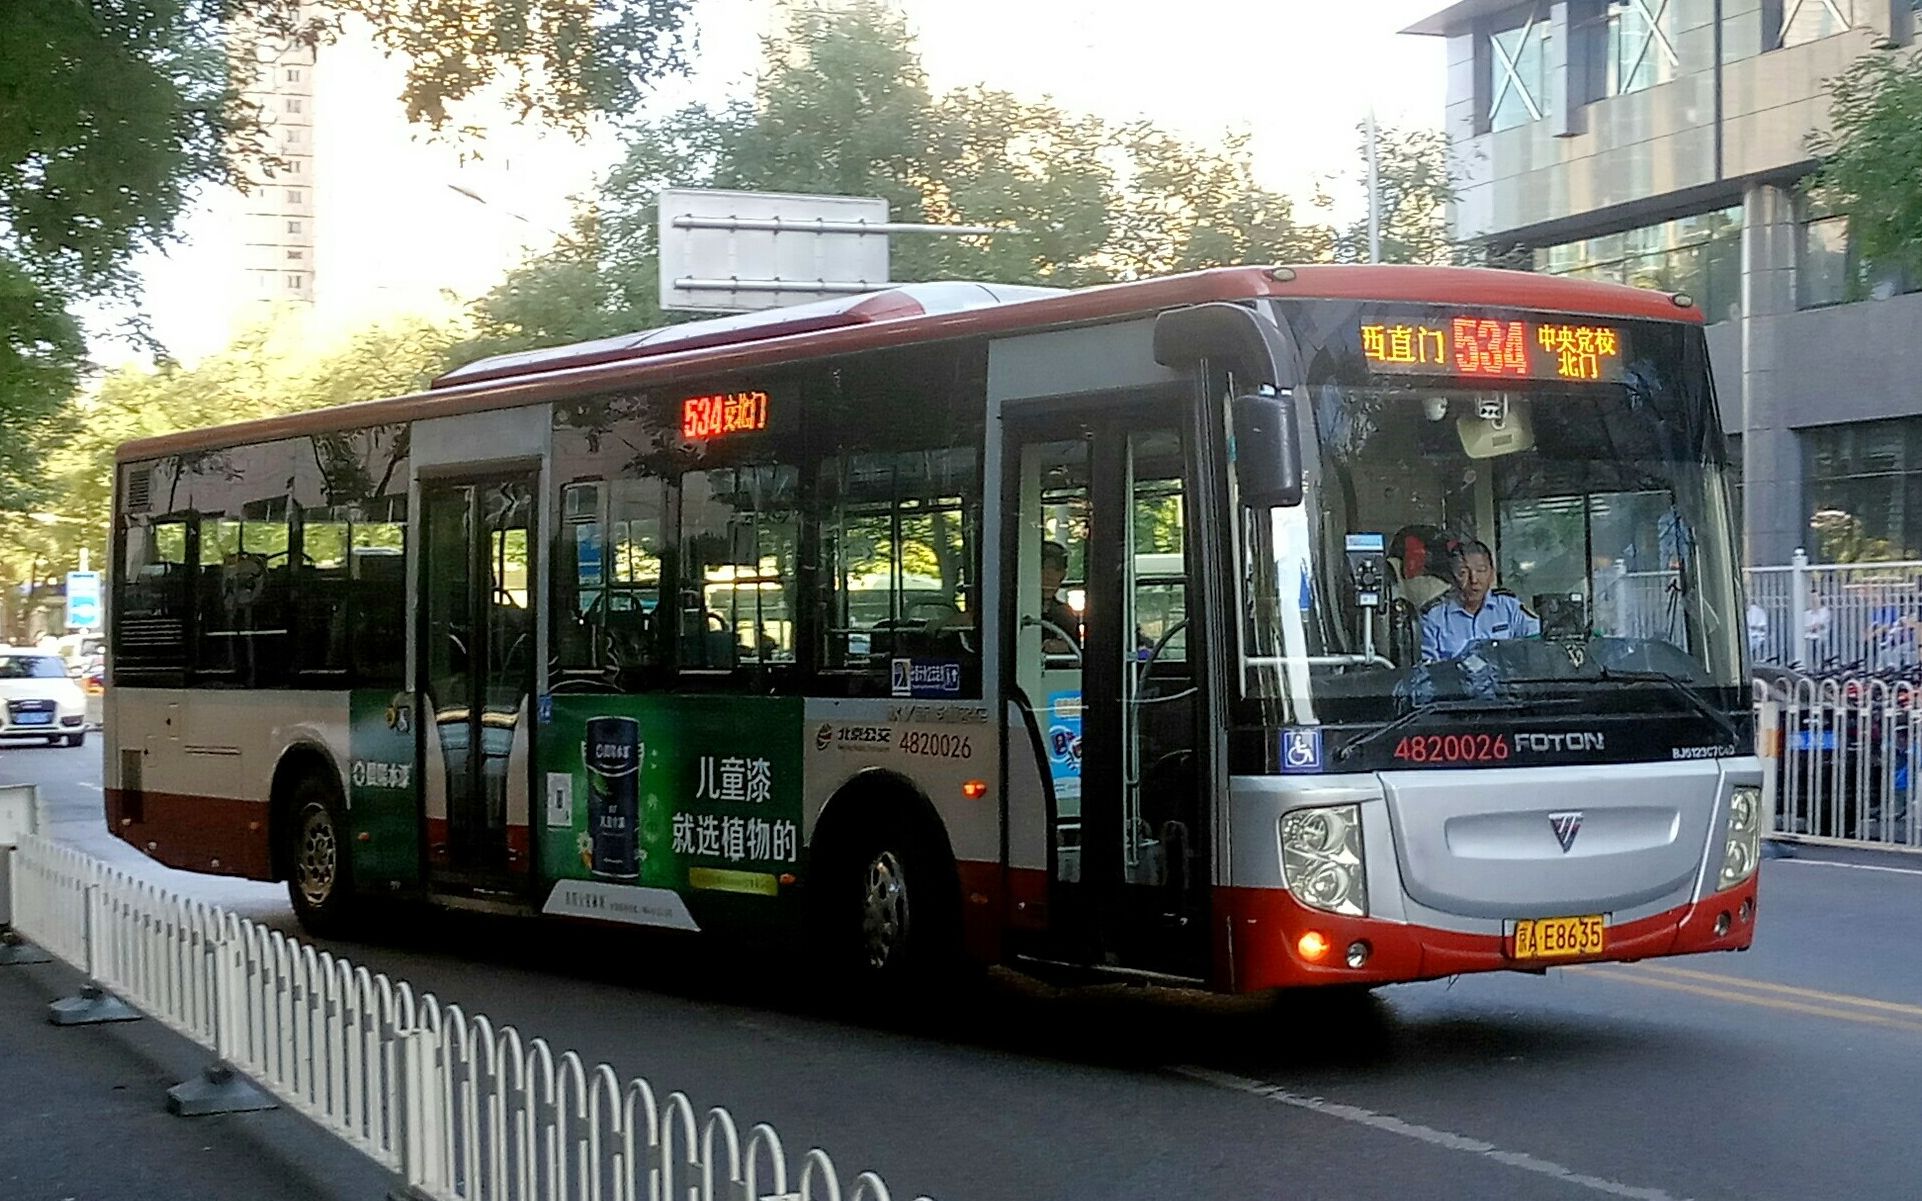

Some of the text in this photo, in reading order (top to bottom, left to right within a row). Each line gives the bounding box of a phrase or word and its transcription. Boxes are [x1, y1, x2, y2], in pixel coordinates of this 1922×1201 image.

[1360, 317, 1616, 374] 西直门 534 中央党校
[1558, 352, 1598, 379] 北门
[684, 396, 722, 437] 534
[900, 731, 972, 759] 4820026
[1394, 734, 1509, 762] 4820026
[1514, 731, 1605, 753] FOTON
[696, 756, 771, 803] 儿童漆
[671, 811, 797, 863] 就选植物的
